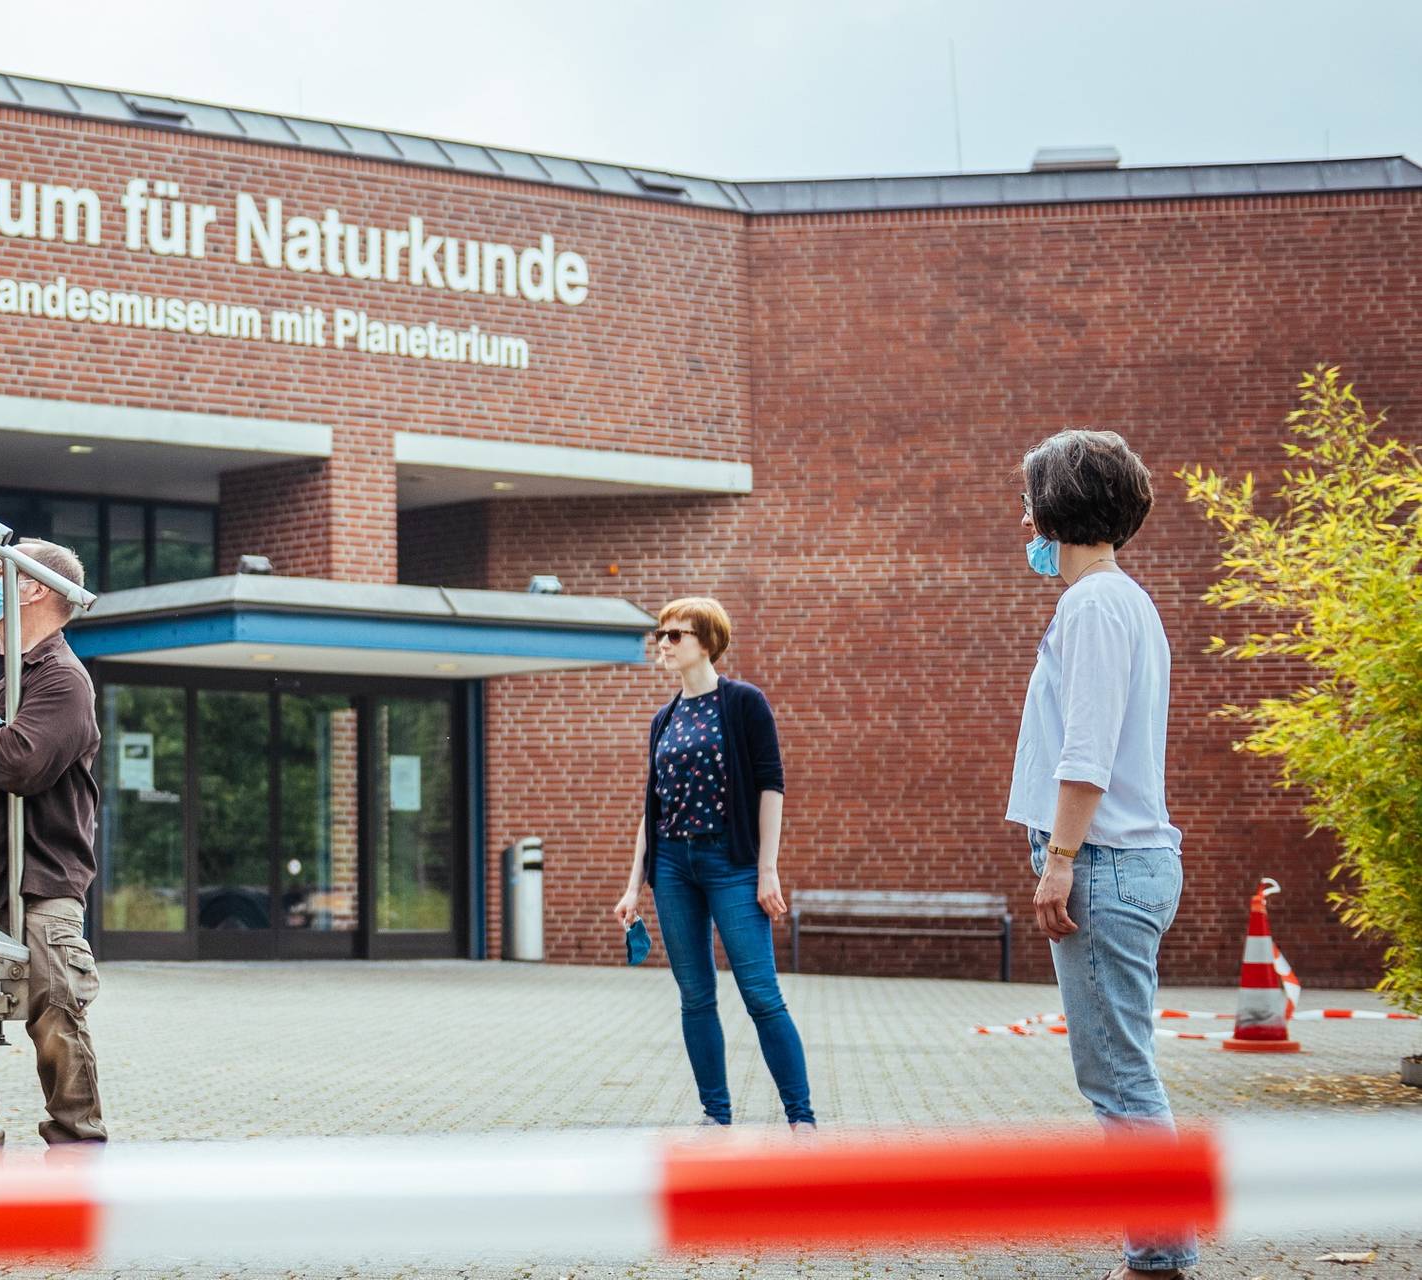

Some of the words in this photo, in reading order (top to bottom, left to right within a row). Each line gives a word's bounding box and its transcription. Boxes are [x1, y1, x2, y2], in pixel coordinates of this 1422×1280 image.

[121, 178, 217, 259] für
[234, 192, 590, 305] Naturkunde
[270, 306, 326, 347] mit
[333, 308, 530, 370] Planetarium
